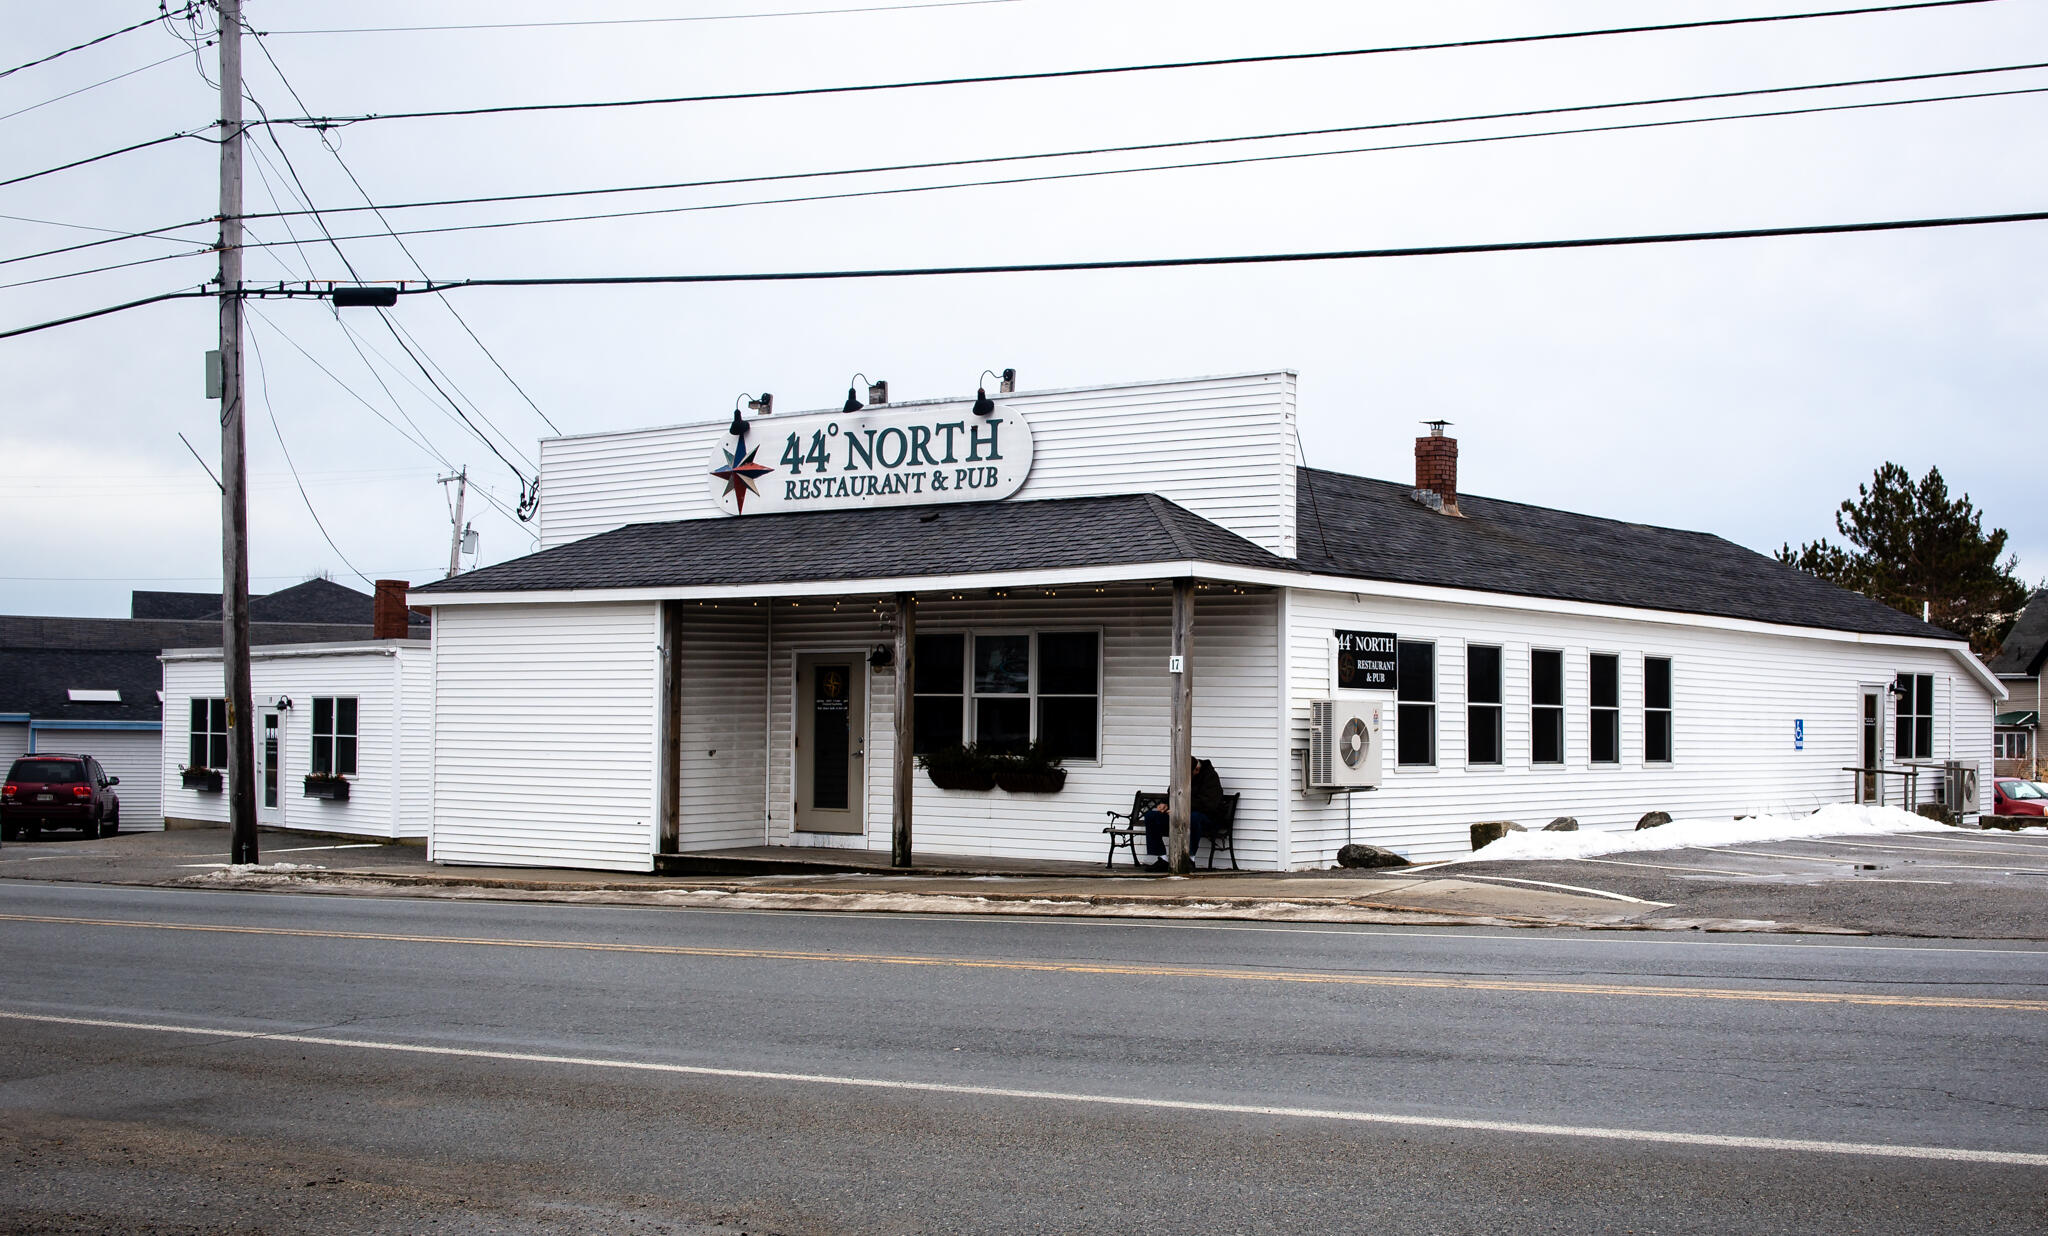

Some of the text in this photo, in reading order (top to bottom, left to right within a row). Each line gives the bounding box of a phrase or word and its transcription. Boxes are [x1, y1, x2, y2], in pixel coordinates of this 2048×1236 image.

[843, 419, 1003, 471] NORTH
[784, 466, 999, 500] RESTAURANT & PUB
[1355, 636, 1394, 652] NORTH
[1172, 659, 1179, 670] 17
[1357, 660, 1395, 671] RESTAURANT
[1366, 672, 1385, 682] & PUB
